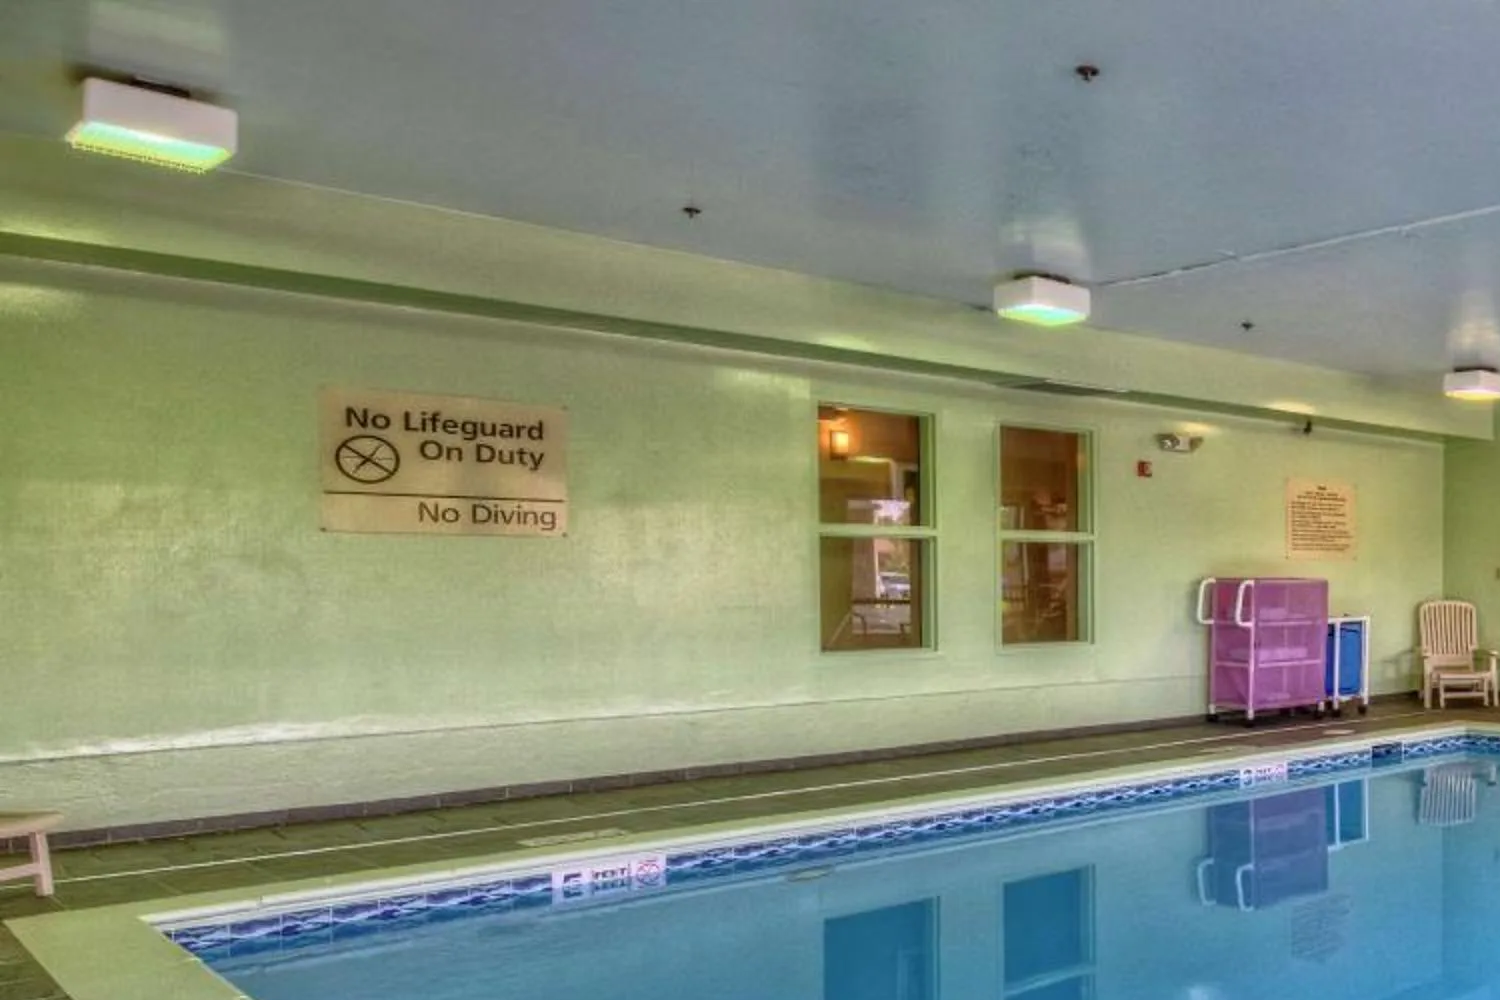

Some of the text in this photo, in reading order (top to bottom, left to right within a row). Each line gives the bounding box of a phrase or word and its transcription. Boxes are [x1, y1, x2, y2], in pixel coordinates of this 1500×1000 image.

[345, 406, 544, 441] No Lifeguard
[419, 439, 544, 471] On Duty
[418, 501, 556, 531] No Diving
